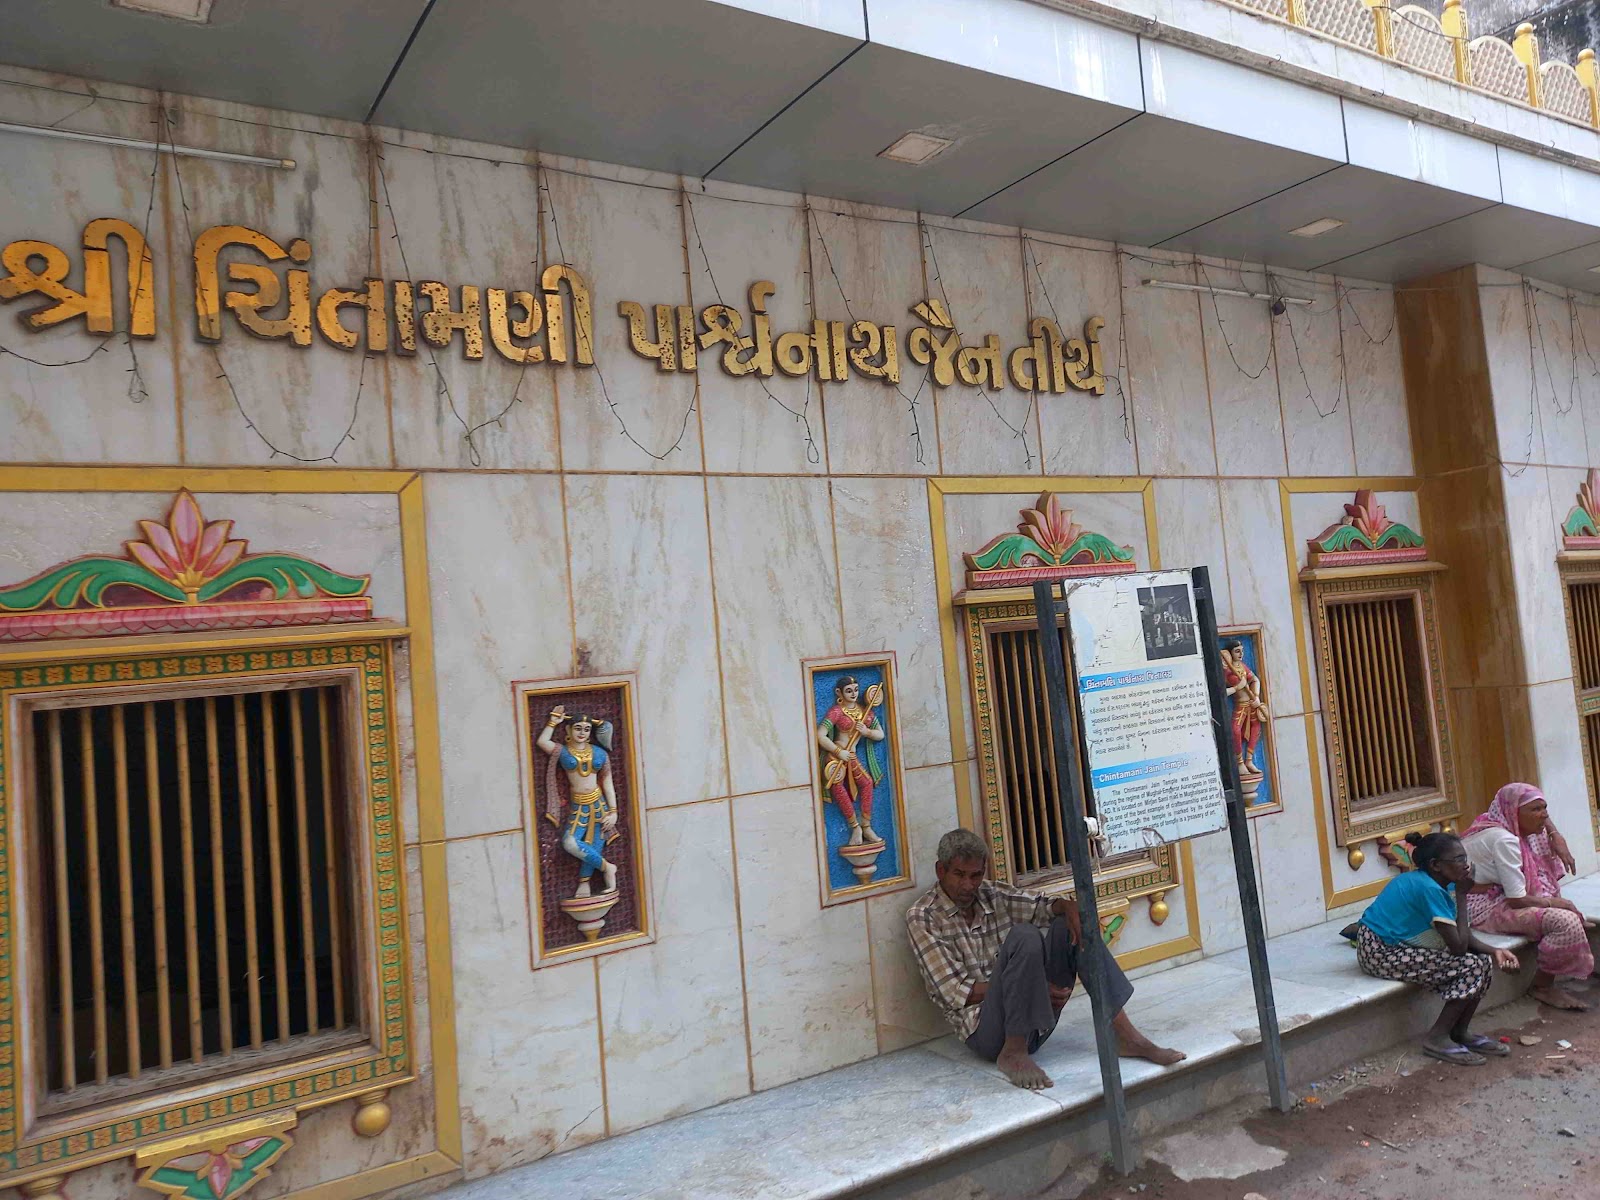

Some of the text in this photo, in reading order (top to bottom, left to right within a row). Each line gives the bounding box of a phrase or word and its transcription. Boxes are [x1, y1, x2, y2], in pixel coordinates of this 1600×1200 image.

[0, 218, 155, 340] શ્રી
[1098, 759, 1189, 783] Chintamani Jain Temple
